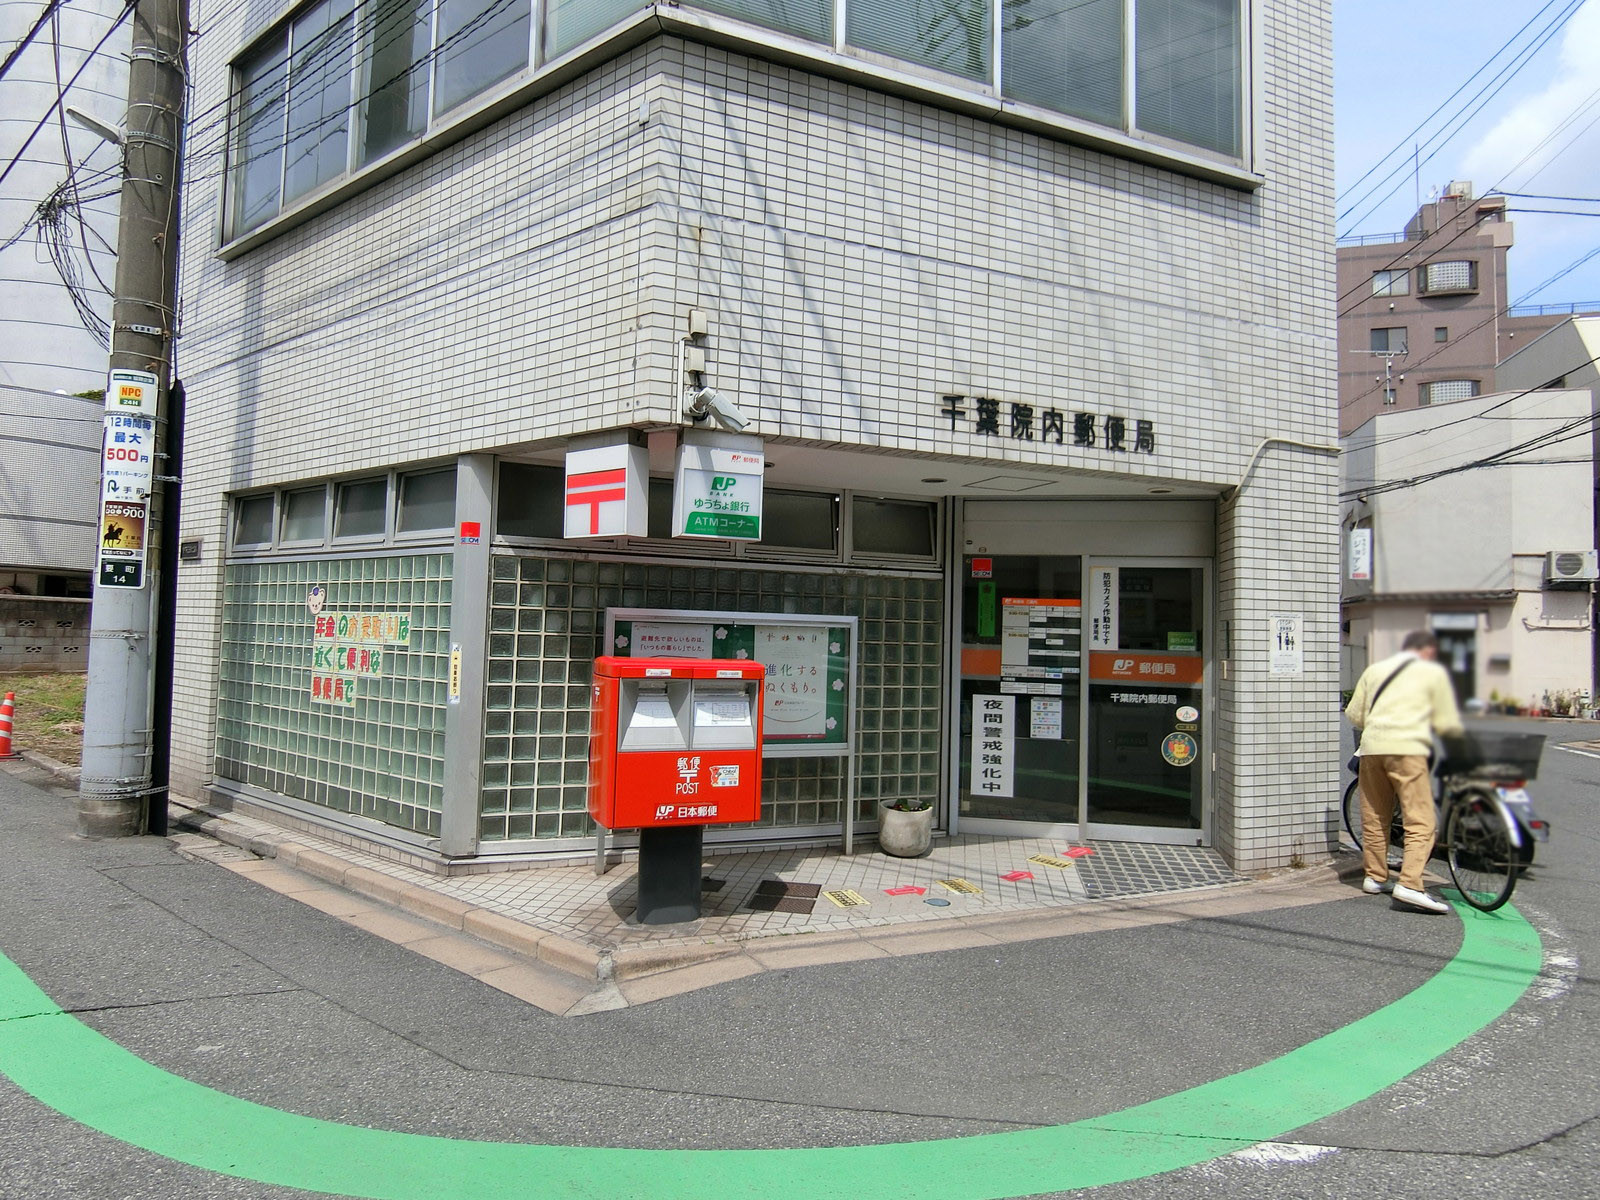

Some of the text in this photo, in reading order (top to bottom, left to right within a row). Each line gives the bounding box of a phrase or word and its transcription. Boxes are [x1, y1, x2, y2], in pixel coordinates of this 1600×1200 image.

[121, 387, 142, 398] NPC
[110, 416, 152, 430] 12時間毎
[941, 395, 1155, 454] 千葉院内郵便局
[114, 431, 142, 444] 最大
[107, 448, 149, 463] 500円
[123, 486, 145, 495] 手前
[711, 476, 737, 491] JP
[694, 498, 750, 513] ゆうちょ銀行
[122, 509, 145, 519] 900
[694, 516, 754, 529] ATMコーナー
[104, 564, 136, 574] 要町
[112, 575, 127, 583] 14
[1102, 572, 1111, 645] 防犯カメラ作動中です
[315, 614, 410, 641] 年金のお受取りは
[313, 645, 381, 673] 近くて便利な
[764, 663, 817, 677] 進化する
[1113, 659, 1176, 676] JP 郵便局
[312, 676, 354, 703] 郵便局で
[1110, 692, 1178, 705] 千葉院内郵便局
[981, 699, 1004, 792] 夜間警戒強化中
[677, 756, 701, 771] 郵便
[675, 782, 700, 795] POST
[678, 805, 718, 818] 日本郵便
